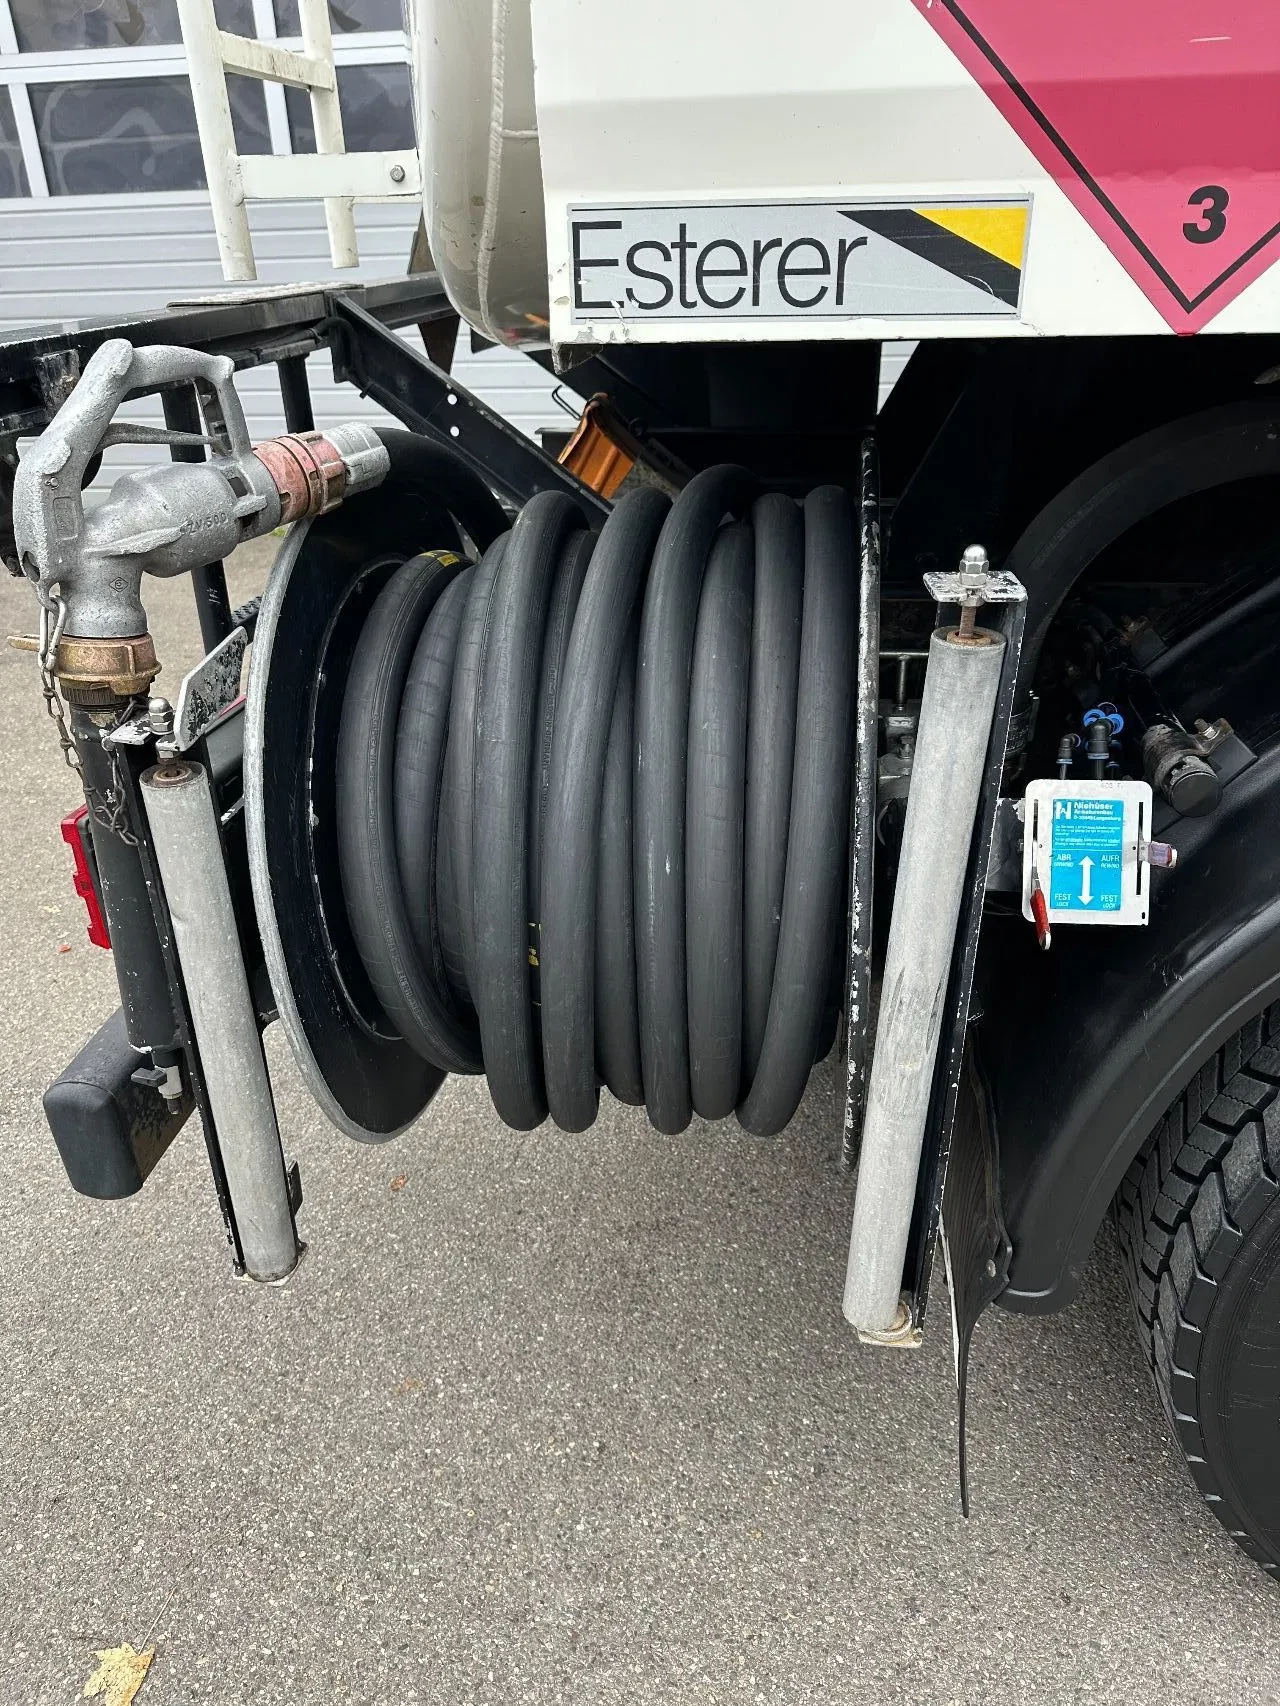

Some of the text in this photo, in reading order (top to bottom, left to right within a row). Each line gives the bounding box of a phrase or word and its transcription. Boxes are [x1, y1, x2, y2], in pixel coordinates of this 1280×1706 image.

[1183, 185, 1229, 244] 3
[572, 220, 868, 310] Esterer
[1056, 853, 1072, 861] ABR
[1101, 854, 1120, 862] AUFR
[1054, 893, 1072, 901] FEST
[1101, 894, 1119, 902] FEST
